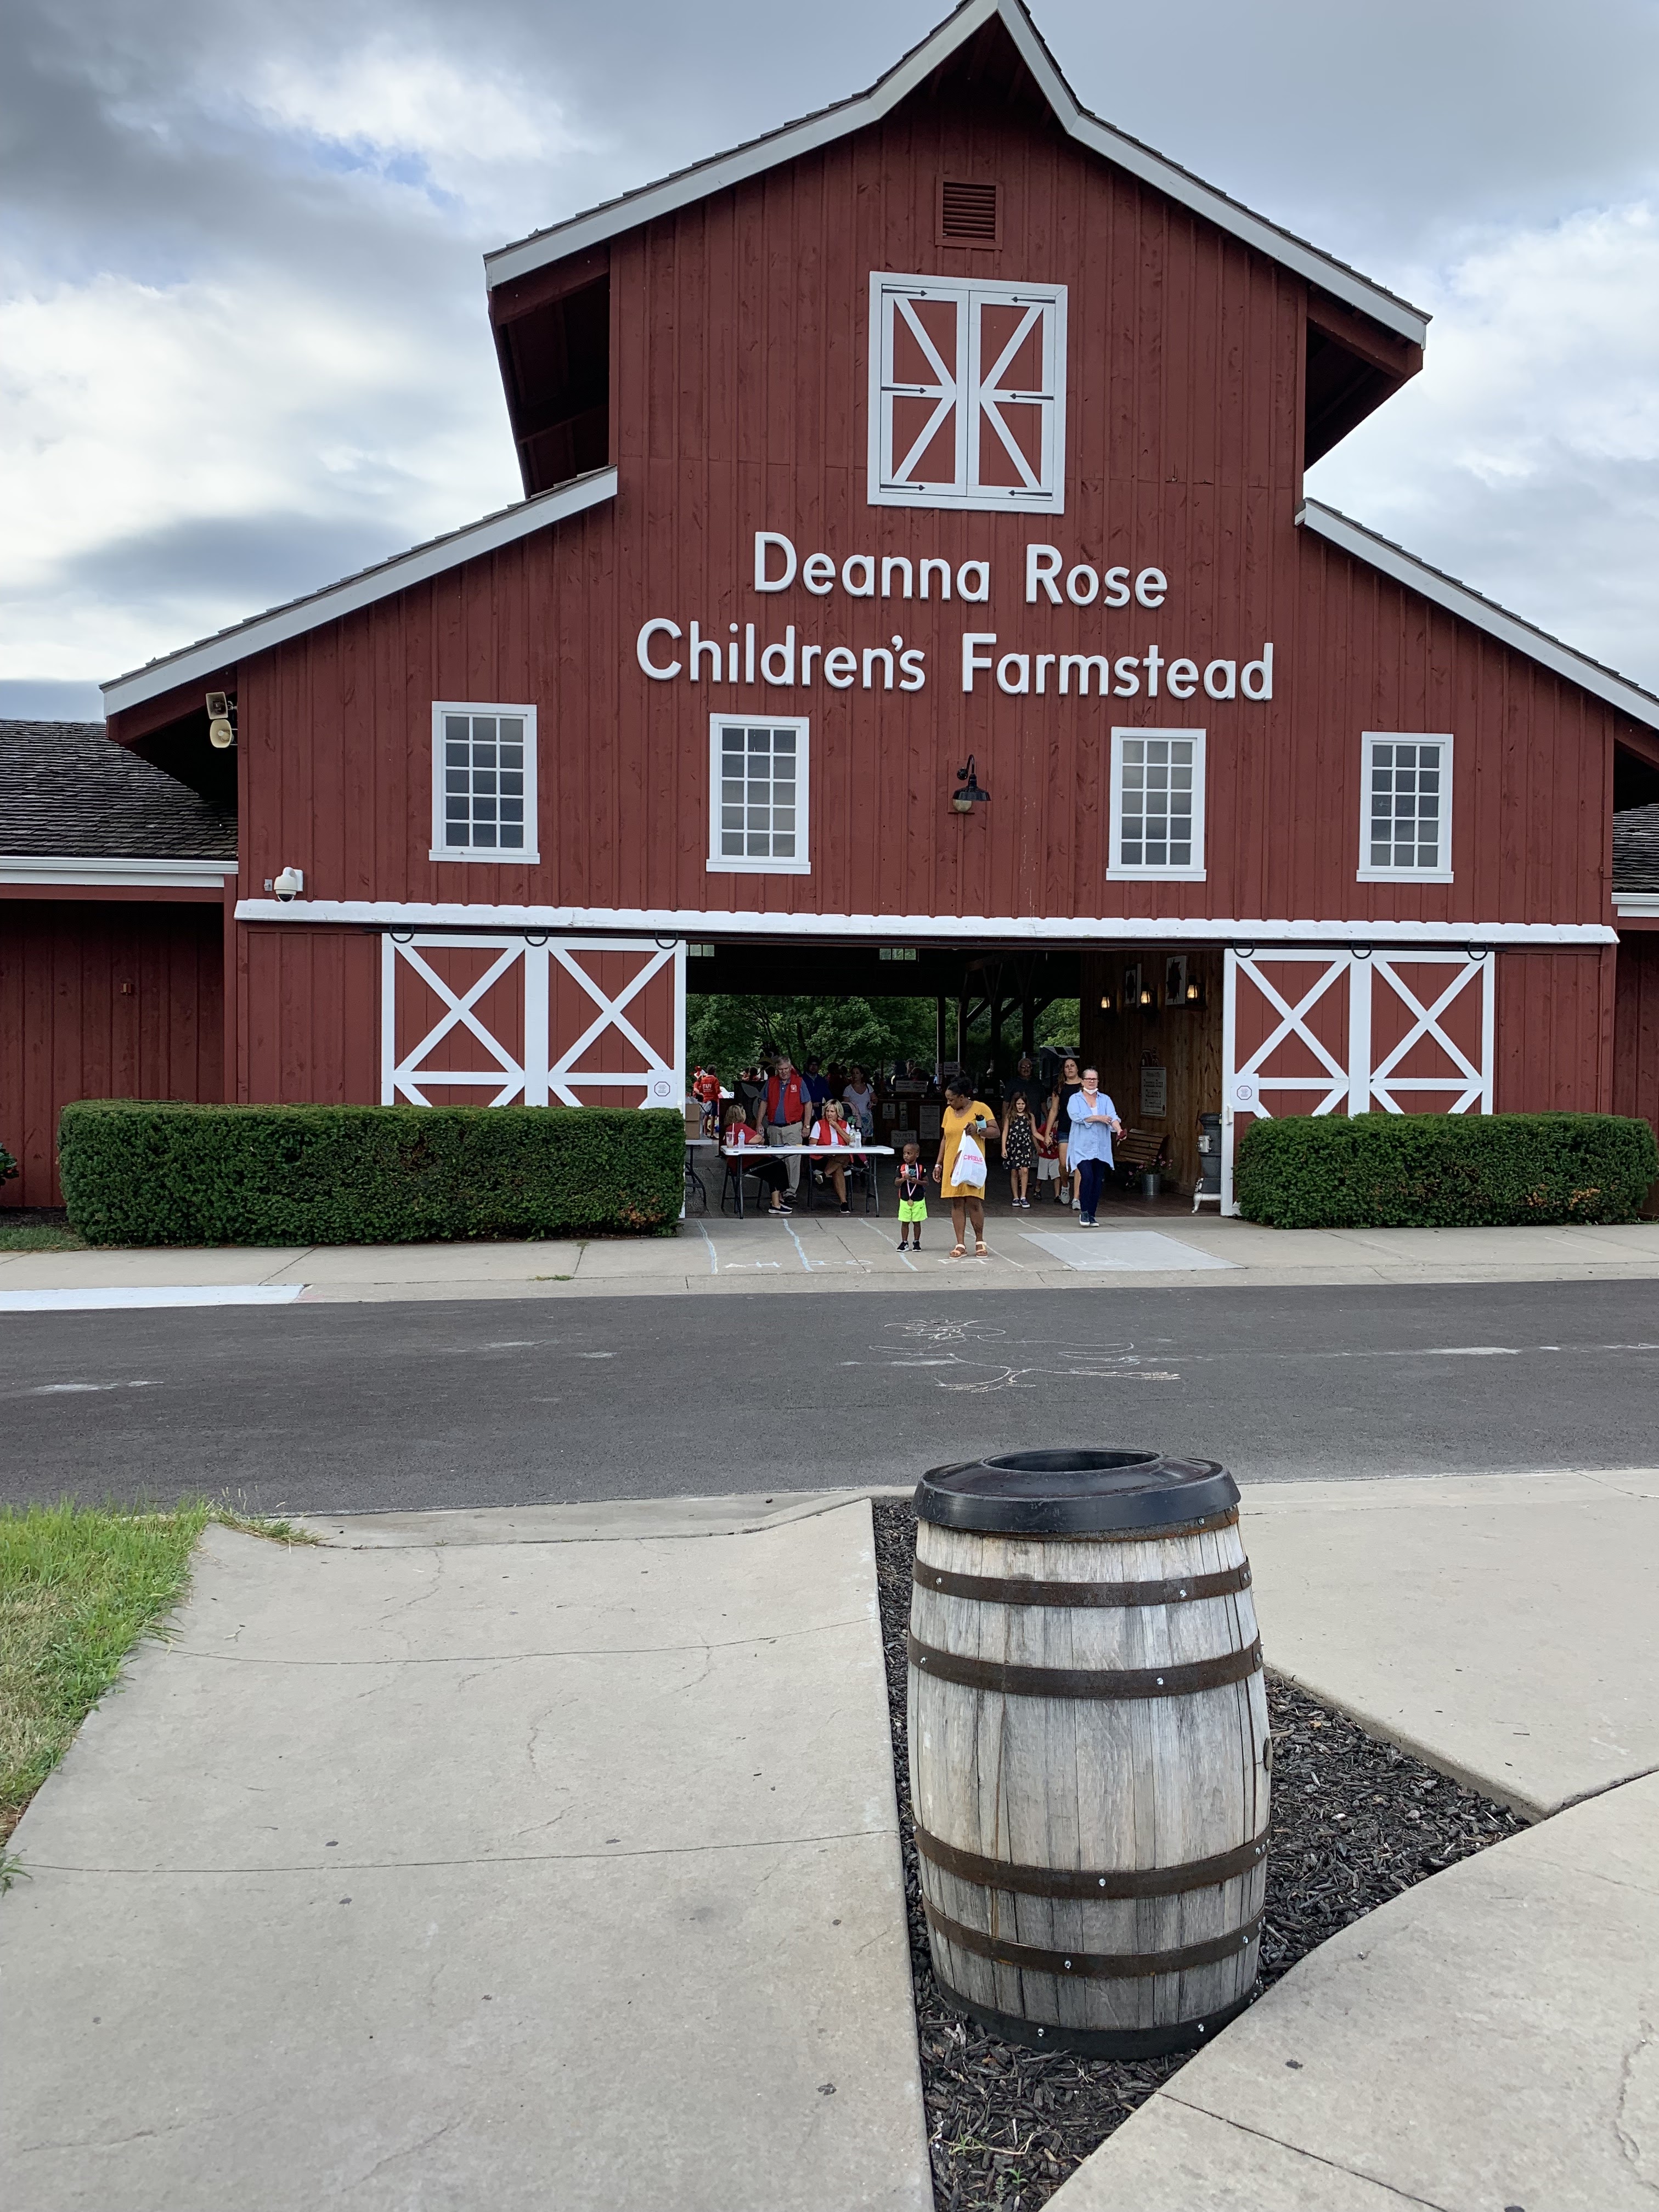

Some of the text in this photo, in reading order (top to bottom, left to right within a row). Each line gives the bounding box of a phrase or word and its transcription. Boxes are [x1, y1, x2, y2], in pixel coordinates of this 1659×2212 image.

[754, 531, 1168, 607] Deanna Rose
[636, 618, 1274, 701] Children's Farmstead
